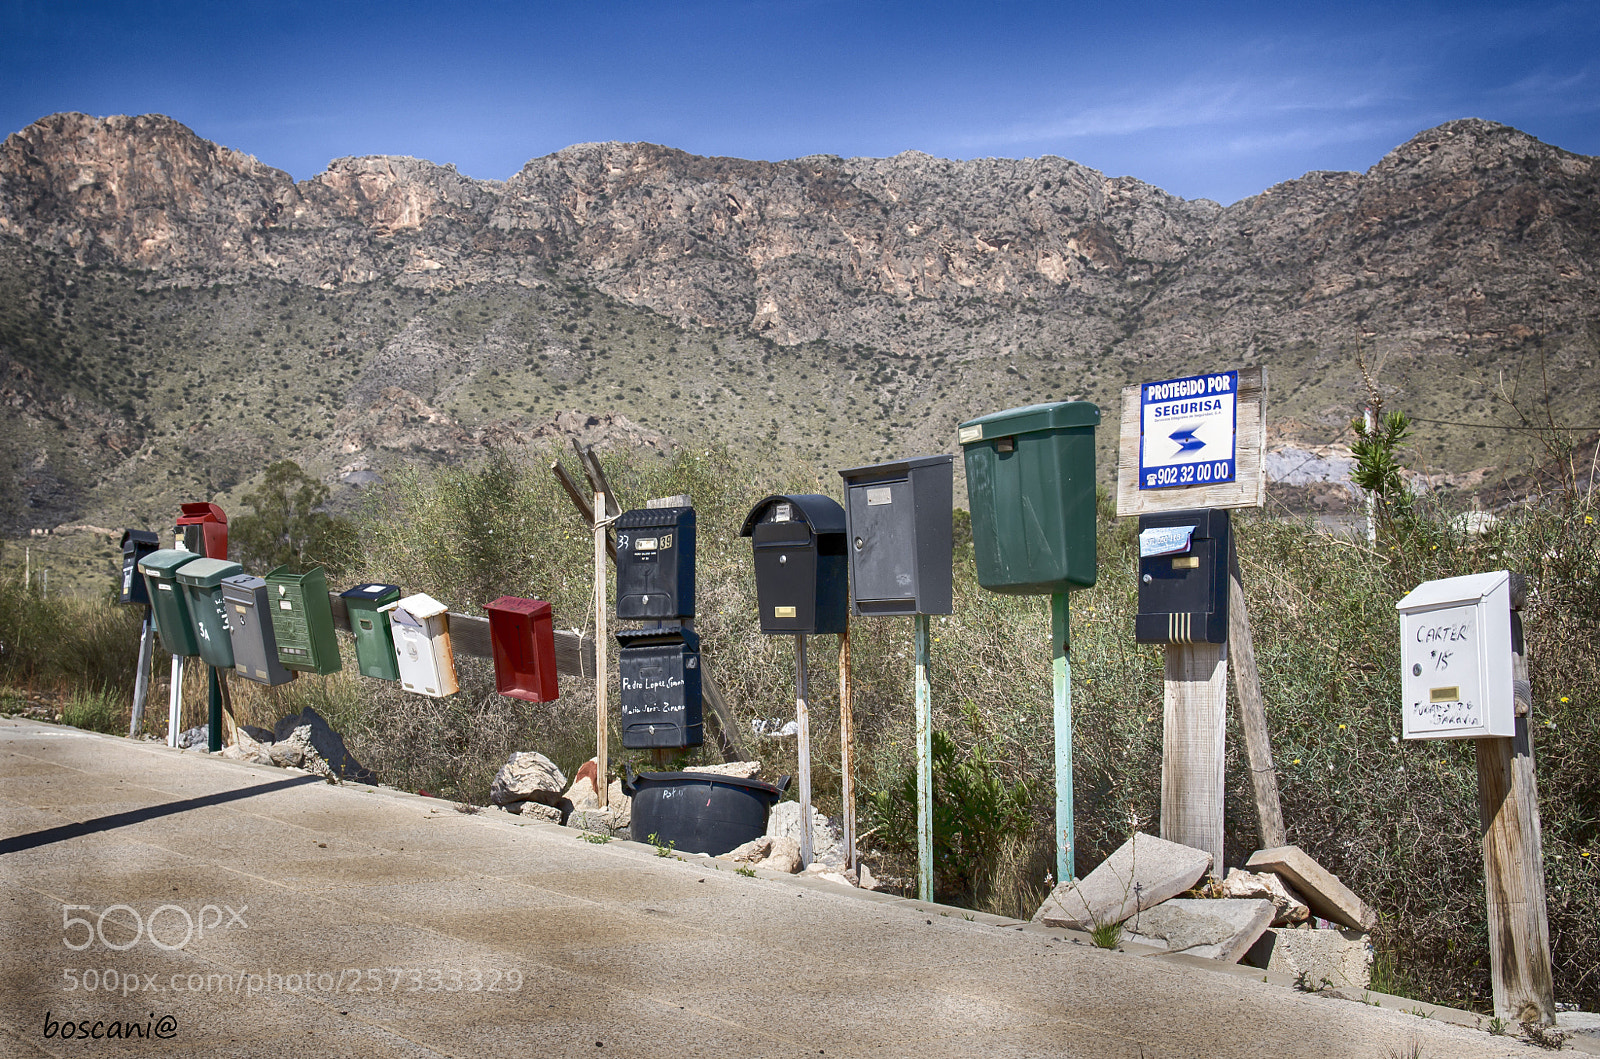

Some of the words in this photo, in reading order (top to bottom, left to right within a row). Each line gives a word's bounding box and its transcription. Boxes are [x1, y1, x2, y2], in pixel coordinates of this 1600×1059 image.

[1148, 378, 1205, 401] PROTEGIDO
[1207, 375, 1231, 393] POR
[1154, 399, 1222, 418] SEGURISA
[1157, 467, 1177, 485] 902
[1180, 465, 1194, 483] 32
[1197, 463, 1211, 481] 00
[1214, 462, 1229, 479] 00
[660, 535, 672, 549] 39
[1416, 624, 1468, 643] CARTER
[622, 677, 643, 691] Pedro
